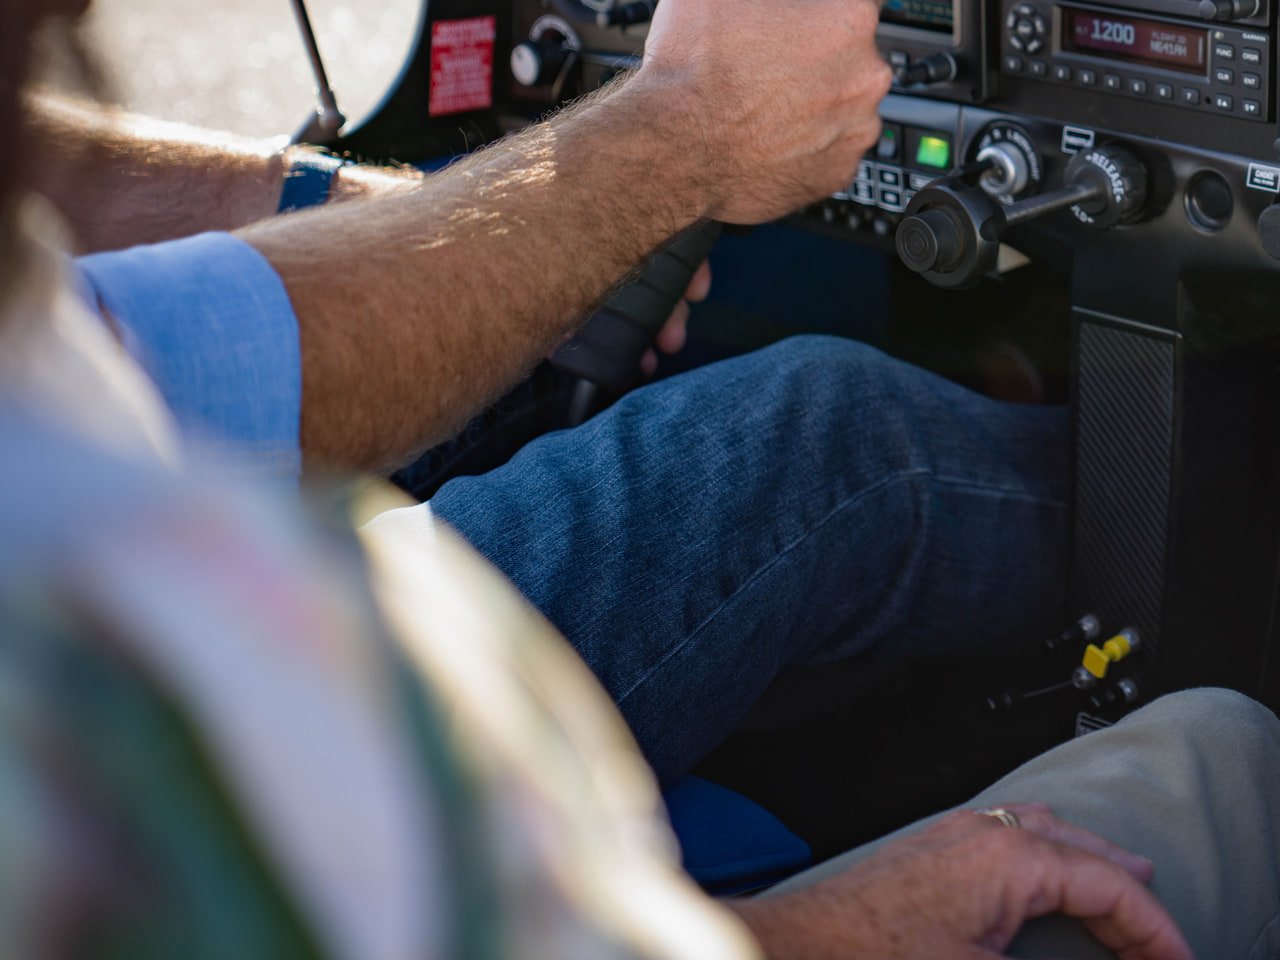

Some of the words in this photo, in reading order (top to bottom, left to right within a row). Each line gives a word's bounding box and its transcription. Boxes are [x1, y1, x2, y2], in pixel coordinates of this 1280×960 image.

[1091, 19, 1135, 45] 1200
[1242, 32, 1266, 42] GARMIN
[1216, 48, 1232, 57] FUNC
[1242, 52, 1259, 61] CRSR
[1217, 72, 1229, 80] CLR
[1244, 77, 1256, 85] ENT
[1186, 92, 1192, 100] 7
[1092, 152, 1124, 195] RELEASE
